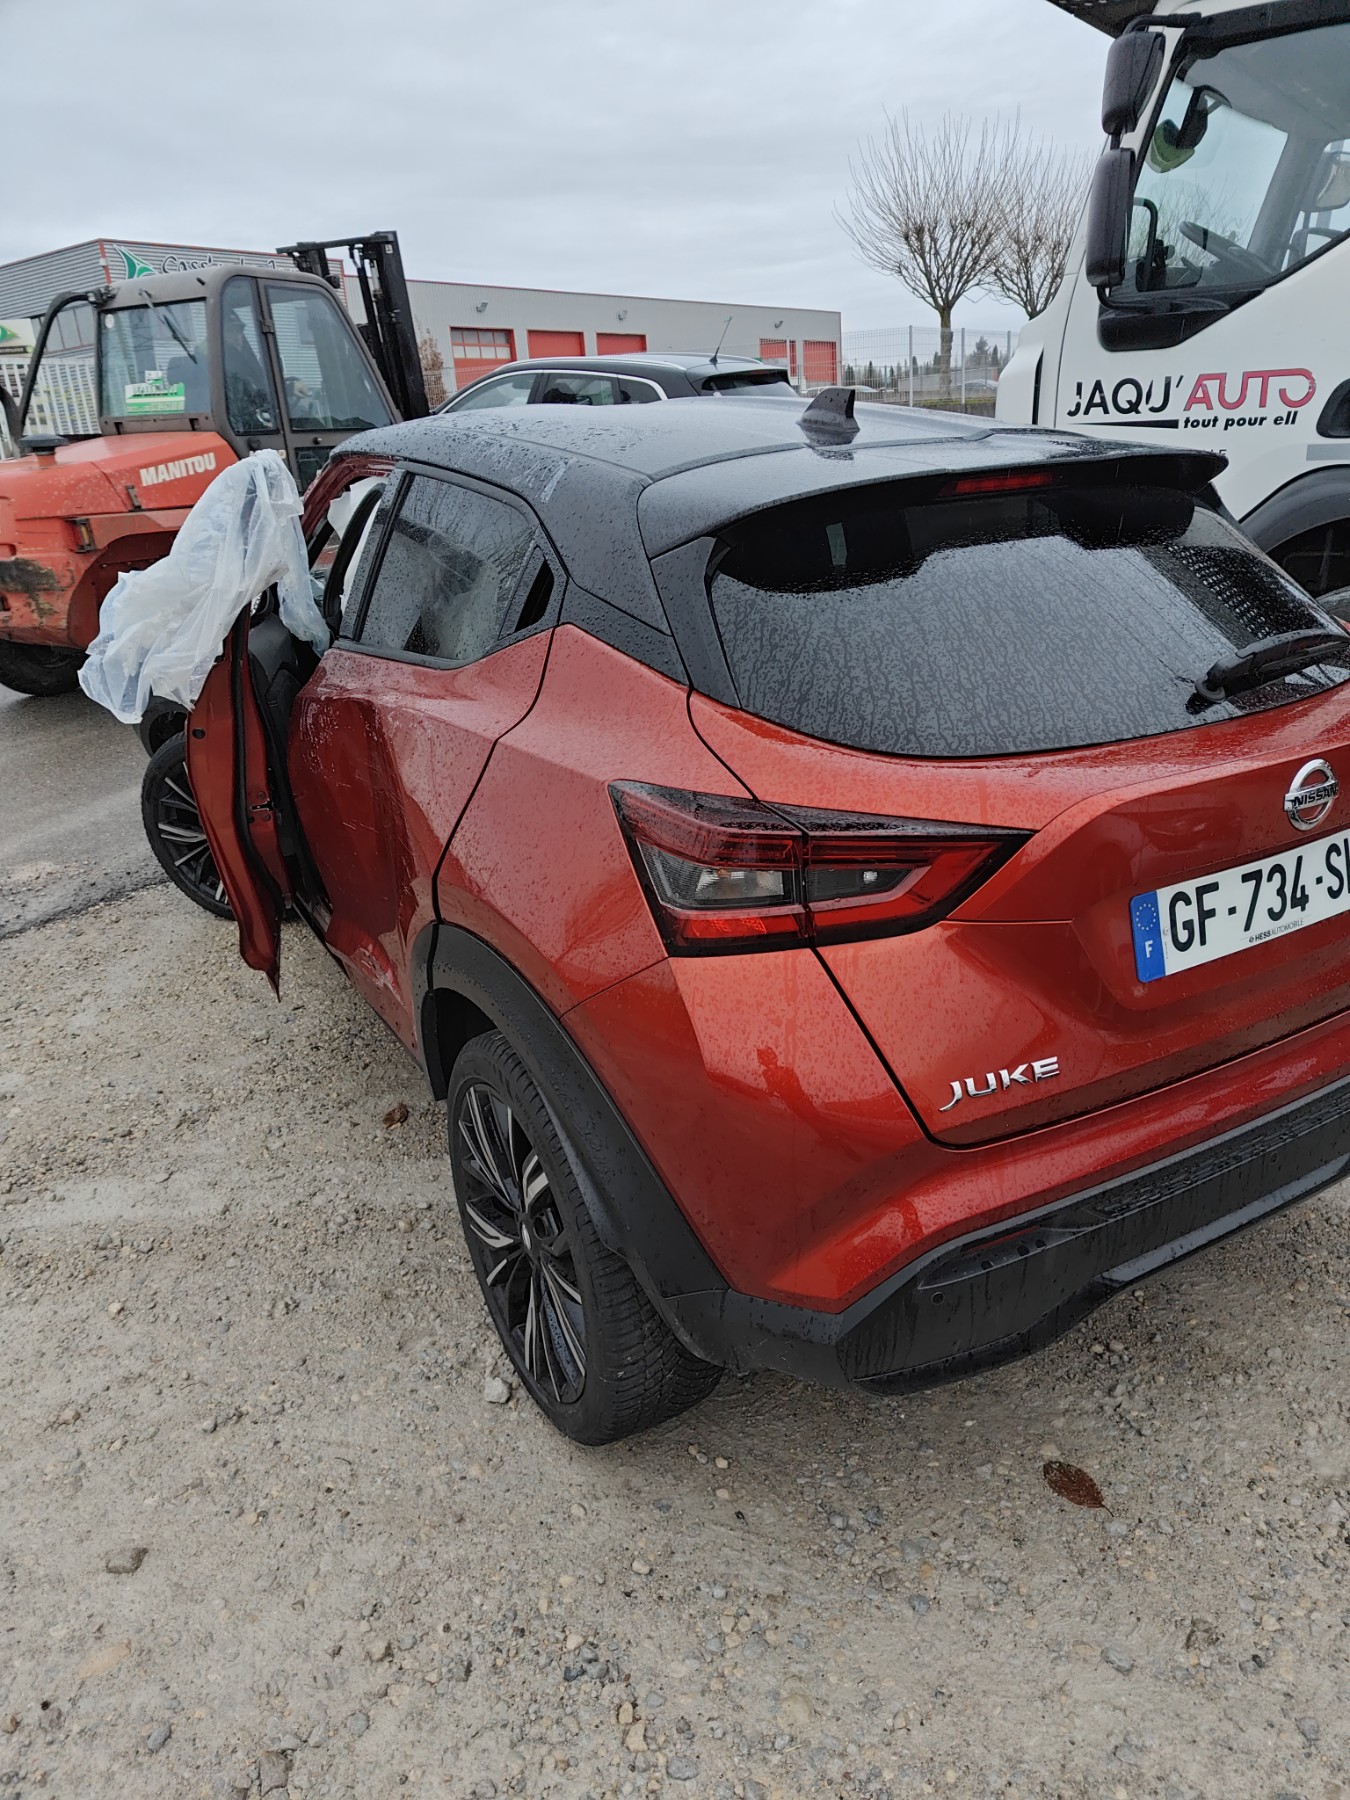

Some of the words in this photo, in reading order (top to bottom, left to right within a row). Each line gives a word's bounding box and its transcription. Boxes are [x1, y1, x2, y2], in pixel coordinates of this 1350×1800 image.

[1183, 416, 1219, 429] tout
[1223, 416, 1267, 431] pour
[1273, 411, 1299, 426] ell
[139, 452, 217, 487] MANITOU
[1293, 782, 1338, 807] NISSAN
[1144, 938, 1154, 959] F
[938, 1056, 1060, 1112] JUKE
